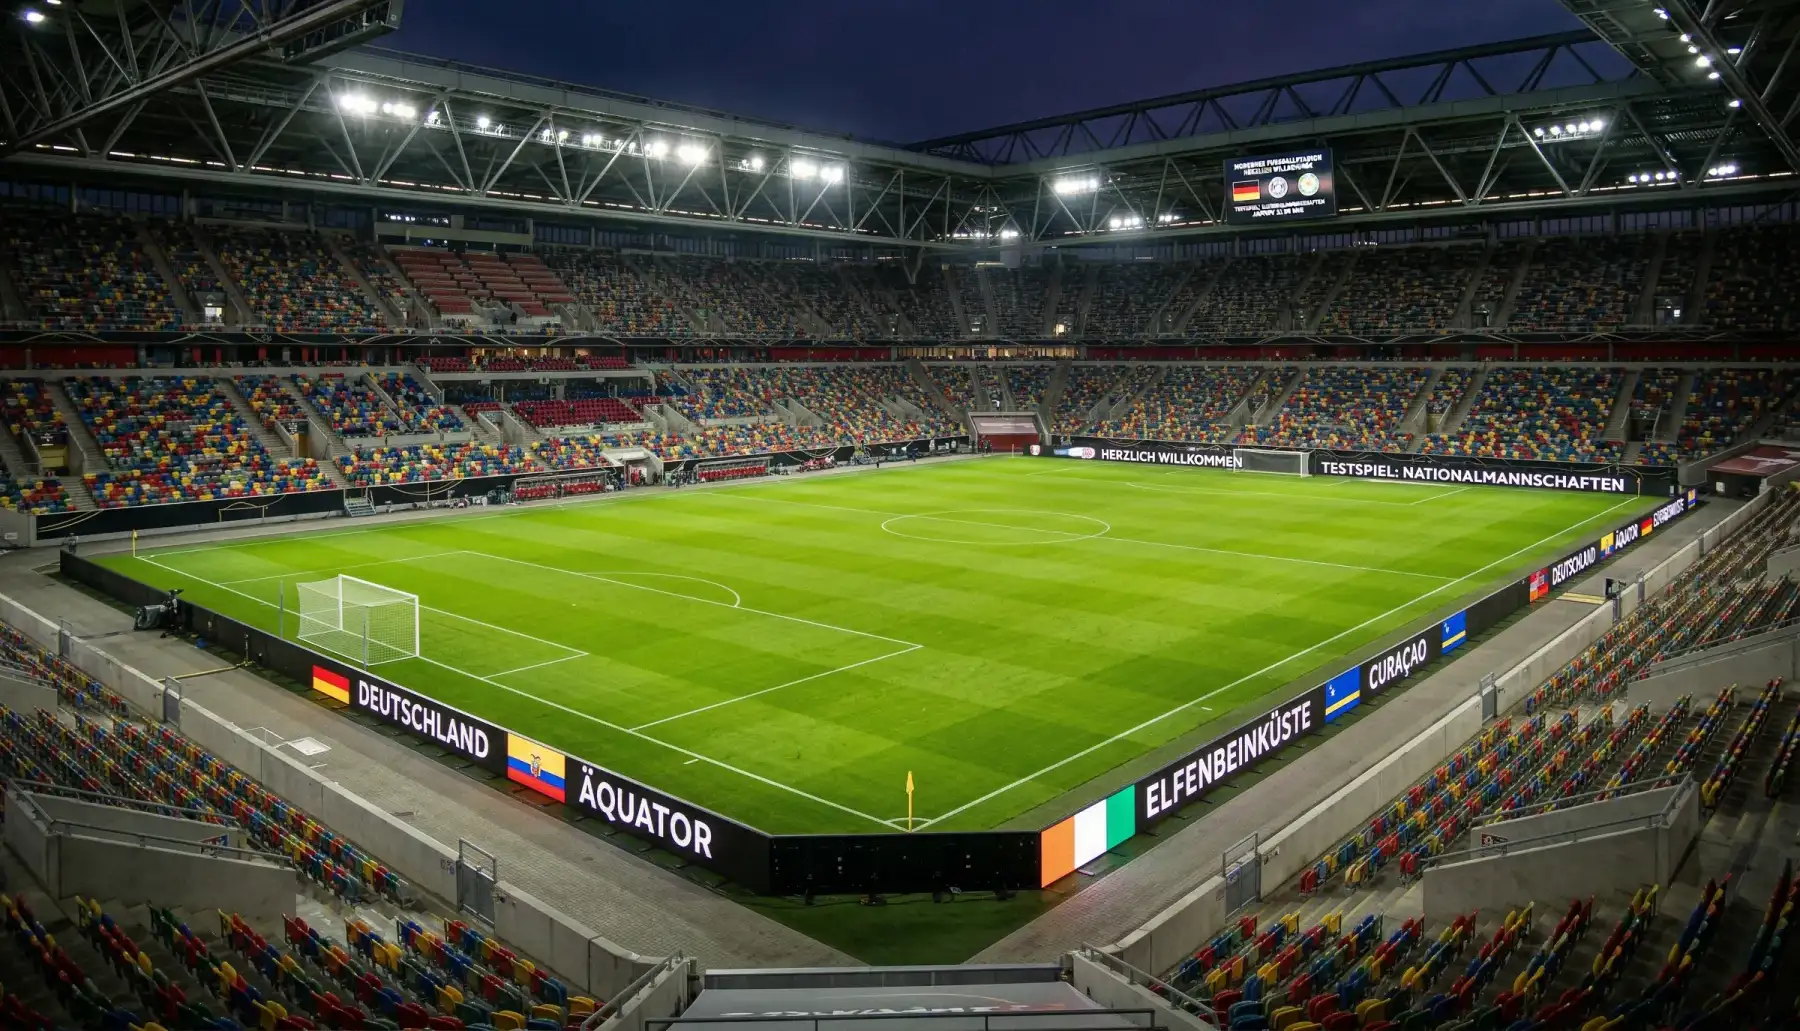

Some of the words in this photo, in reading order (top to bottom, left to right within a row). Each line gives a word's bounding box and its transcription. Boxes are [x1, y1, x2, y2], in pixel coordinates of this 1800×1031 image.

[1101, 449, 1155, 463] HERZLICH
[1159, 451, 1243, 468] WILLKOMMEN
[1321, 462, 1399, 478] TESTSPIEL:
[1403, 467, 1625, 492] NATIONALMANNSCHAFTEN
[1552, 547, 1596, 585] DEUTSCHLAND
[1369, 638, 1427, 690] CURAÇAO
[358, 680, 489, 759] DEUTSCHLAND
[1146, 700, 1312, 818] ELFENBEINKÜSTE
[578, 765, 713, 859] ÄQUATOR
